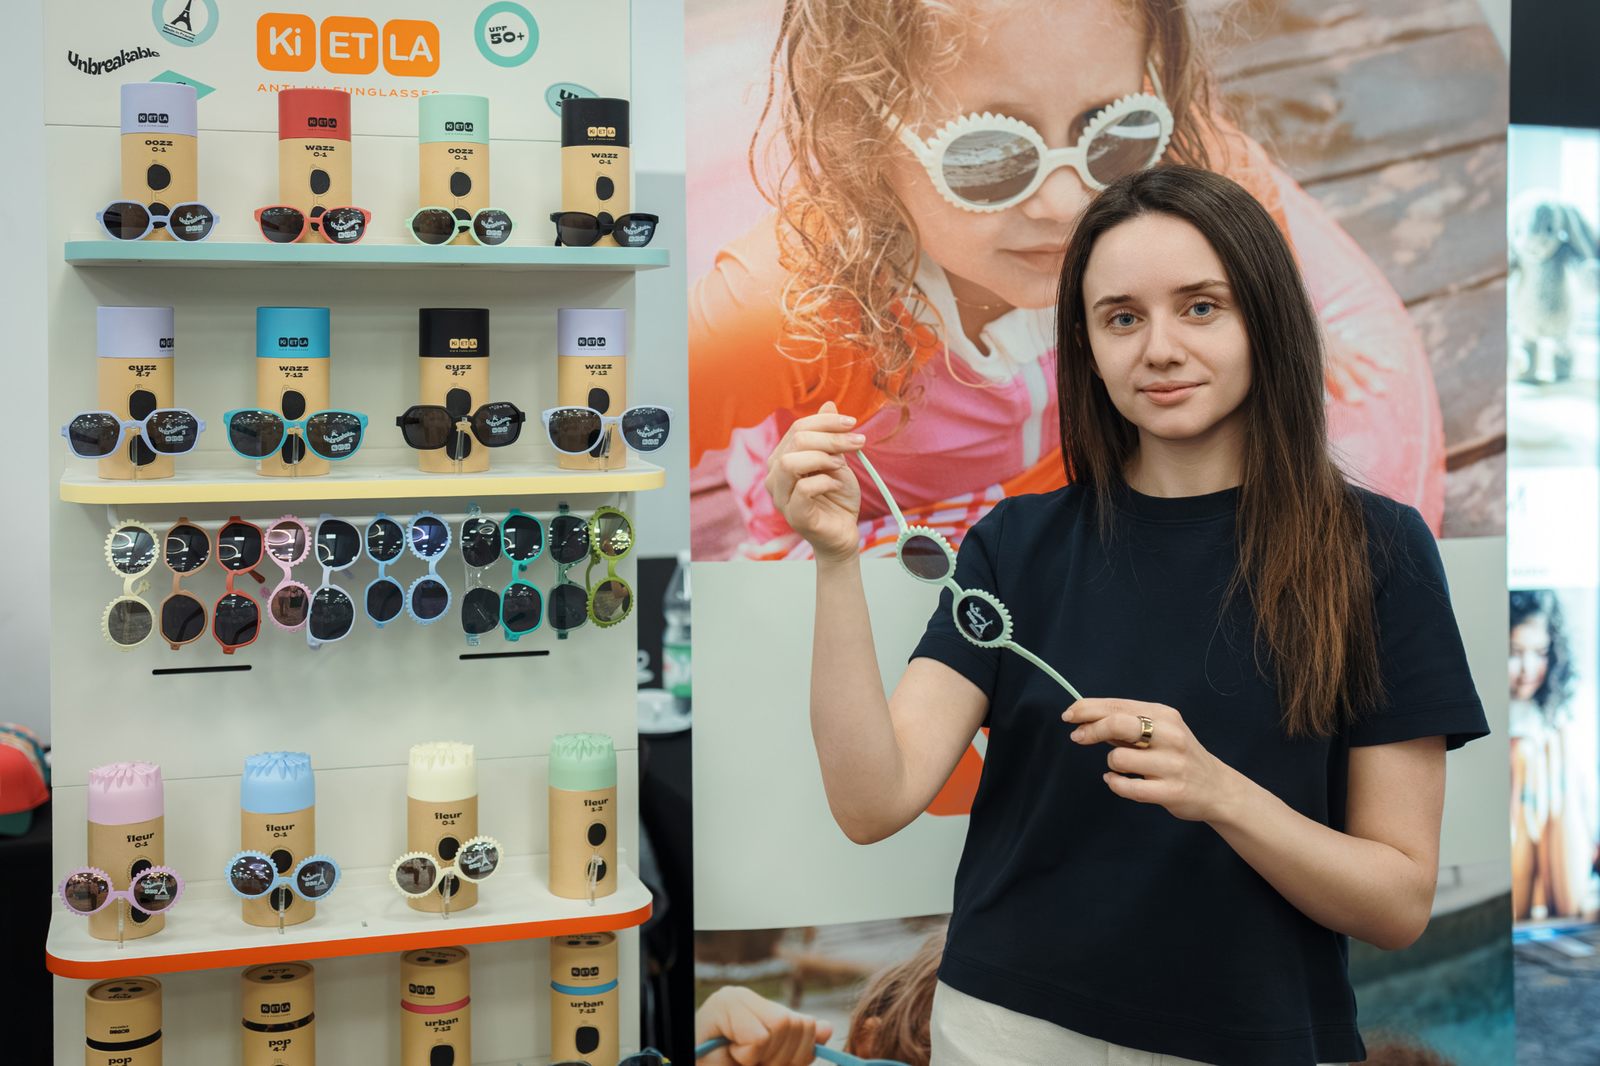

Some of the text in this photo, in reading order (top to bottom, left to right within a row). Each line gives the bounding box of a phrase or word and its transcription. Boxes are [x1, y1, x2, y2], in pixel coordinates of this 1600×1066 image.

[490, 32, 524, 44] 50+
[330, 31, 373, 60] ET
[390, 34, 433, 62] LA
[68, 46, 160, 75] Unbreakable
[128, 364, 157, 372] eyzz
[584, 798, 608, 806] fleur
[127, 832, 154, 842] fleur
[425, 1018, 458, 1027] urban
[269, 1039, 291, 1048] pop
[108, 1057, 132, 1065] pop
